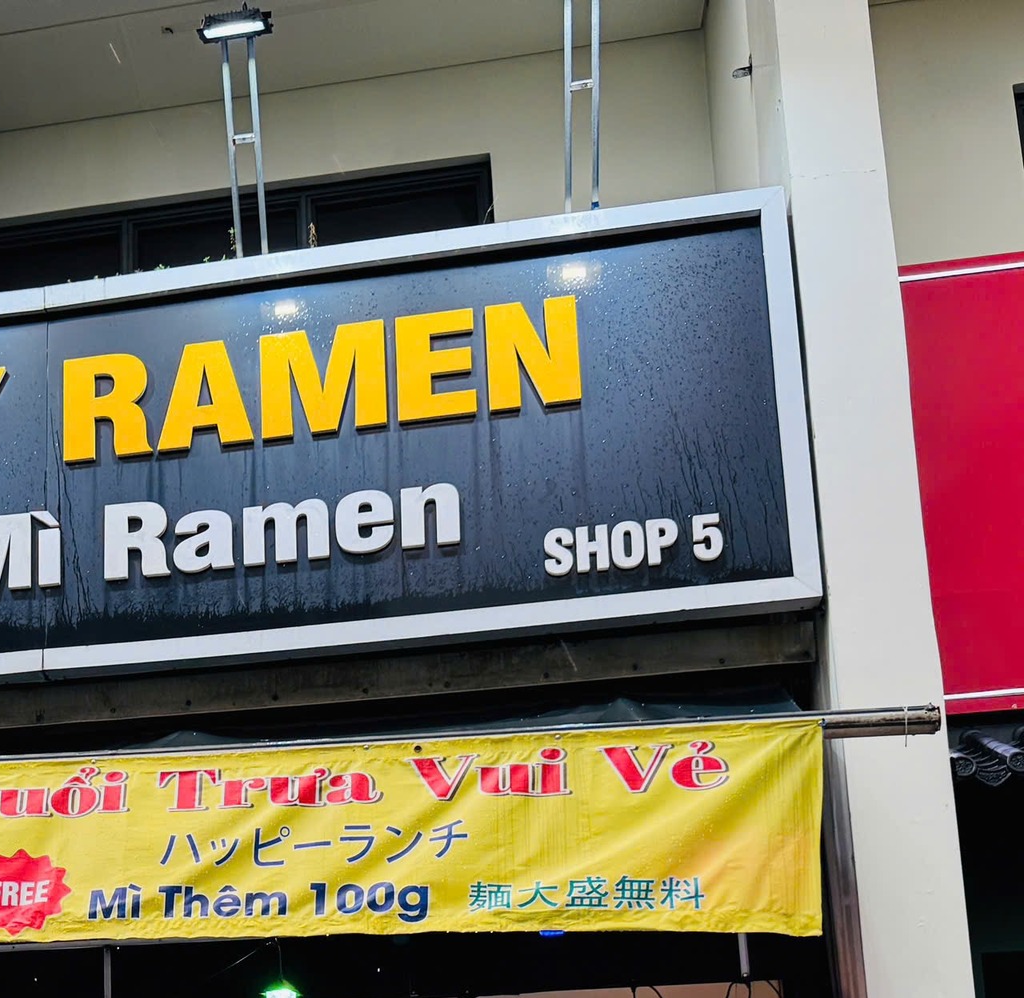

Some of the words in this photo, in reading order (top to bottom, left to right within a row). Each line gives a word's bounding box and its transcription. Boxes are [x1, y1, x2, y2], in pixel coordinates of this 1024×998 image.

[62, 295, 582, 463] RAMEN
[103, 482, 461, 581] Ramen
[543, 517, 678, 576] SHOP
[693, 512, 724, 562] 5
[158, 766, 384, 813] Trưa
[406, 746, 574, 801] Vui
[597, 740, 731, 794] Vẻ
[159, 818, 469, 867] ハッピーランチ
[87, 883, 142, 921] Mì
[158, 884, 288, 919] Thêm
[309, 881, 430, 923] 100g
[468, 874, 706, 913] 麺大盛無料
